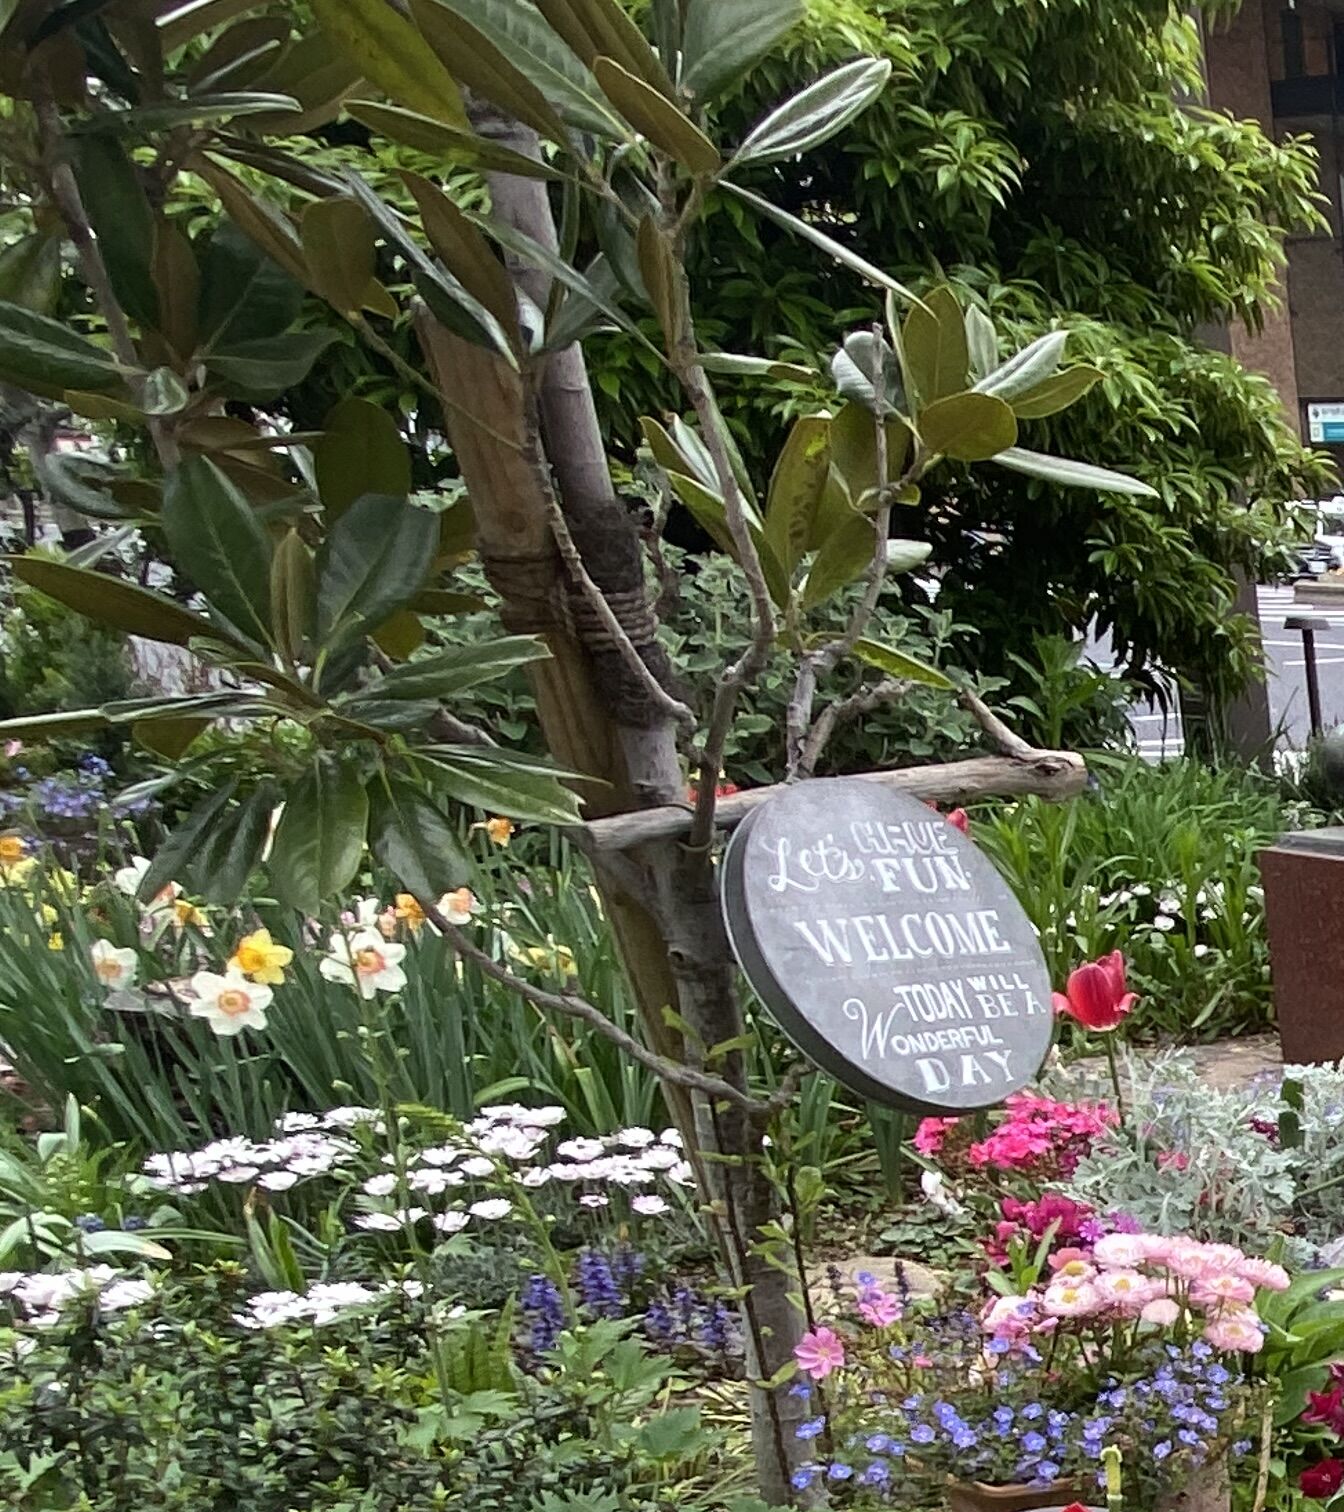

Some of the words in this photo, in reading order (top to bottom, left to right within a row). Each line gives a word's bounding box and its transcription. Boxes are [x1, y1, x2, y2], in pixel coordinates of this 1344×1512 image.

[758, 833, 865, 892] Let's
[850, 821, 959, 855] HAVE
[872, 855, 971, 893] FUN
[795, 909, 1012, 967] WELCOME
[893, 978, 973, 1022] TODAY
[967, 973, 1030, 991] WILL
[976, 992, 1019, 1019] BE
[1025, 991, 1047, 1015] A
[842, 998, 1004, 1060] WONDERFUL
[915, 1049, 1015, 1094] DAY
